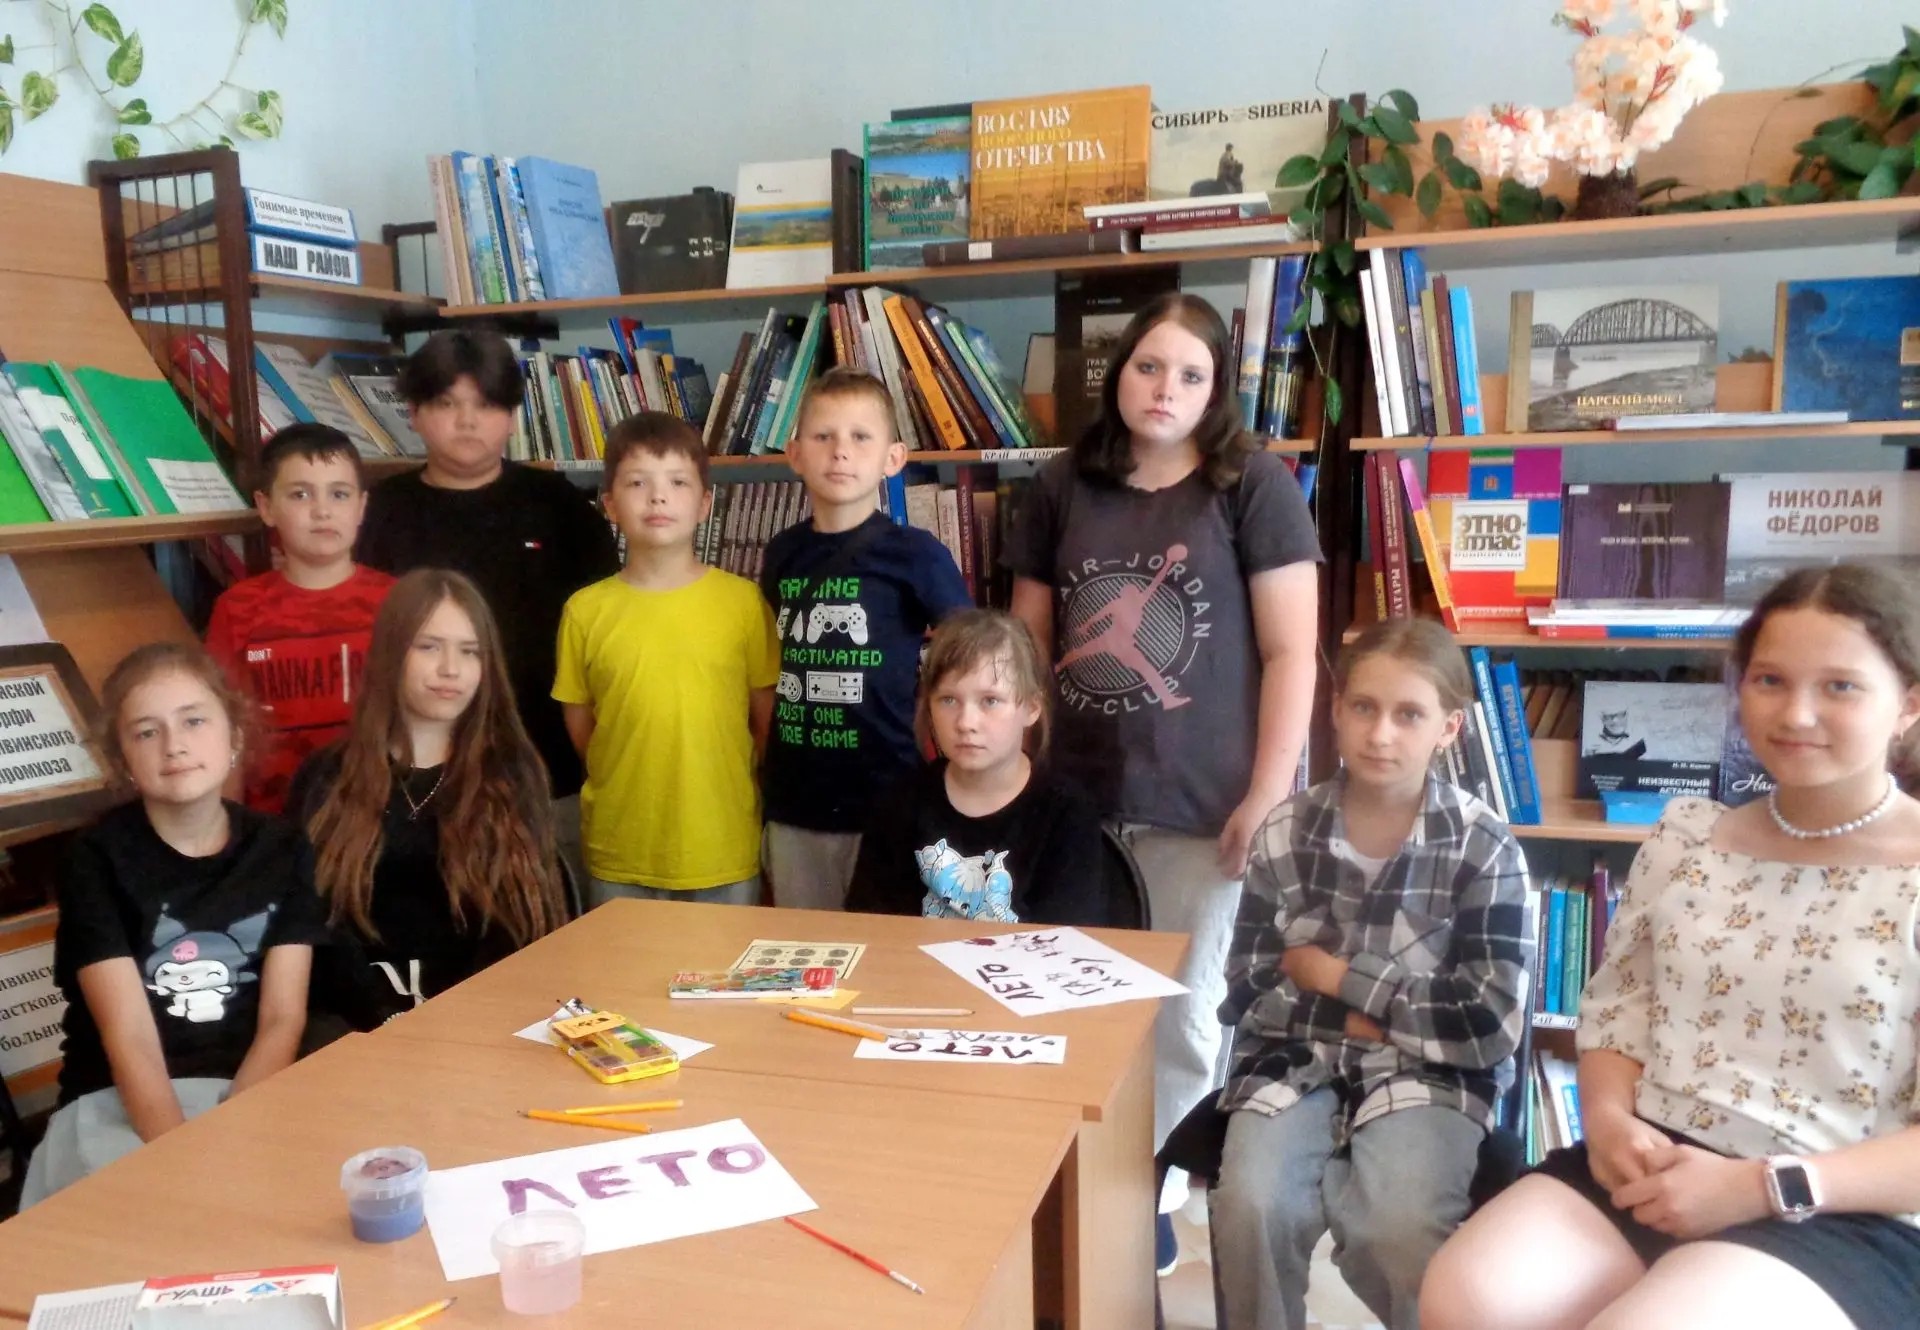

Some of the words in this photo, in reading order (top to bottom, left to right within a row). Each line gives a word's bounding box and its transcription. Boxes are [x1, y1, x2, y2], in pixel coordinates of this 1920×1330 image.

[977, 112, 1005, 135] ВО
[1009, 105, 1071, 131] СЛАВУ
[1151, 109, 1229, 130] СИБИРЬ
[1247, 98, 1323, 121] SIBERIA
[975, 138, 1106, 169] ОТЕЧЕСТВА
[253, 196, 299, 216] Гонимые
[262, 242, 298, 270] НАШ
[306, 248, 351, 278] РАЙОН
[1577, 392, 1642, 406] ЦАРСКИЙ
[1768, 485, 1883, 508] НИКОЛАЙ
[1766, 510, 1880, 536] ФЁДОРОВ
[813, 707, 843, 725] ONE
[811, 729, 859, 748] GAME
[1637, 776, 1710, 787] НЕИЗВЕСТНЫЙ
[976, 963, 1045, 1000] ЛЕТО
[888, 1041, 1033, 1059] ЛЕТО
[501, 1142, 767, 1216] ЛЕТО
[155, 1285, 235, 1304] ГУАШЬ
